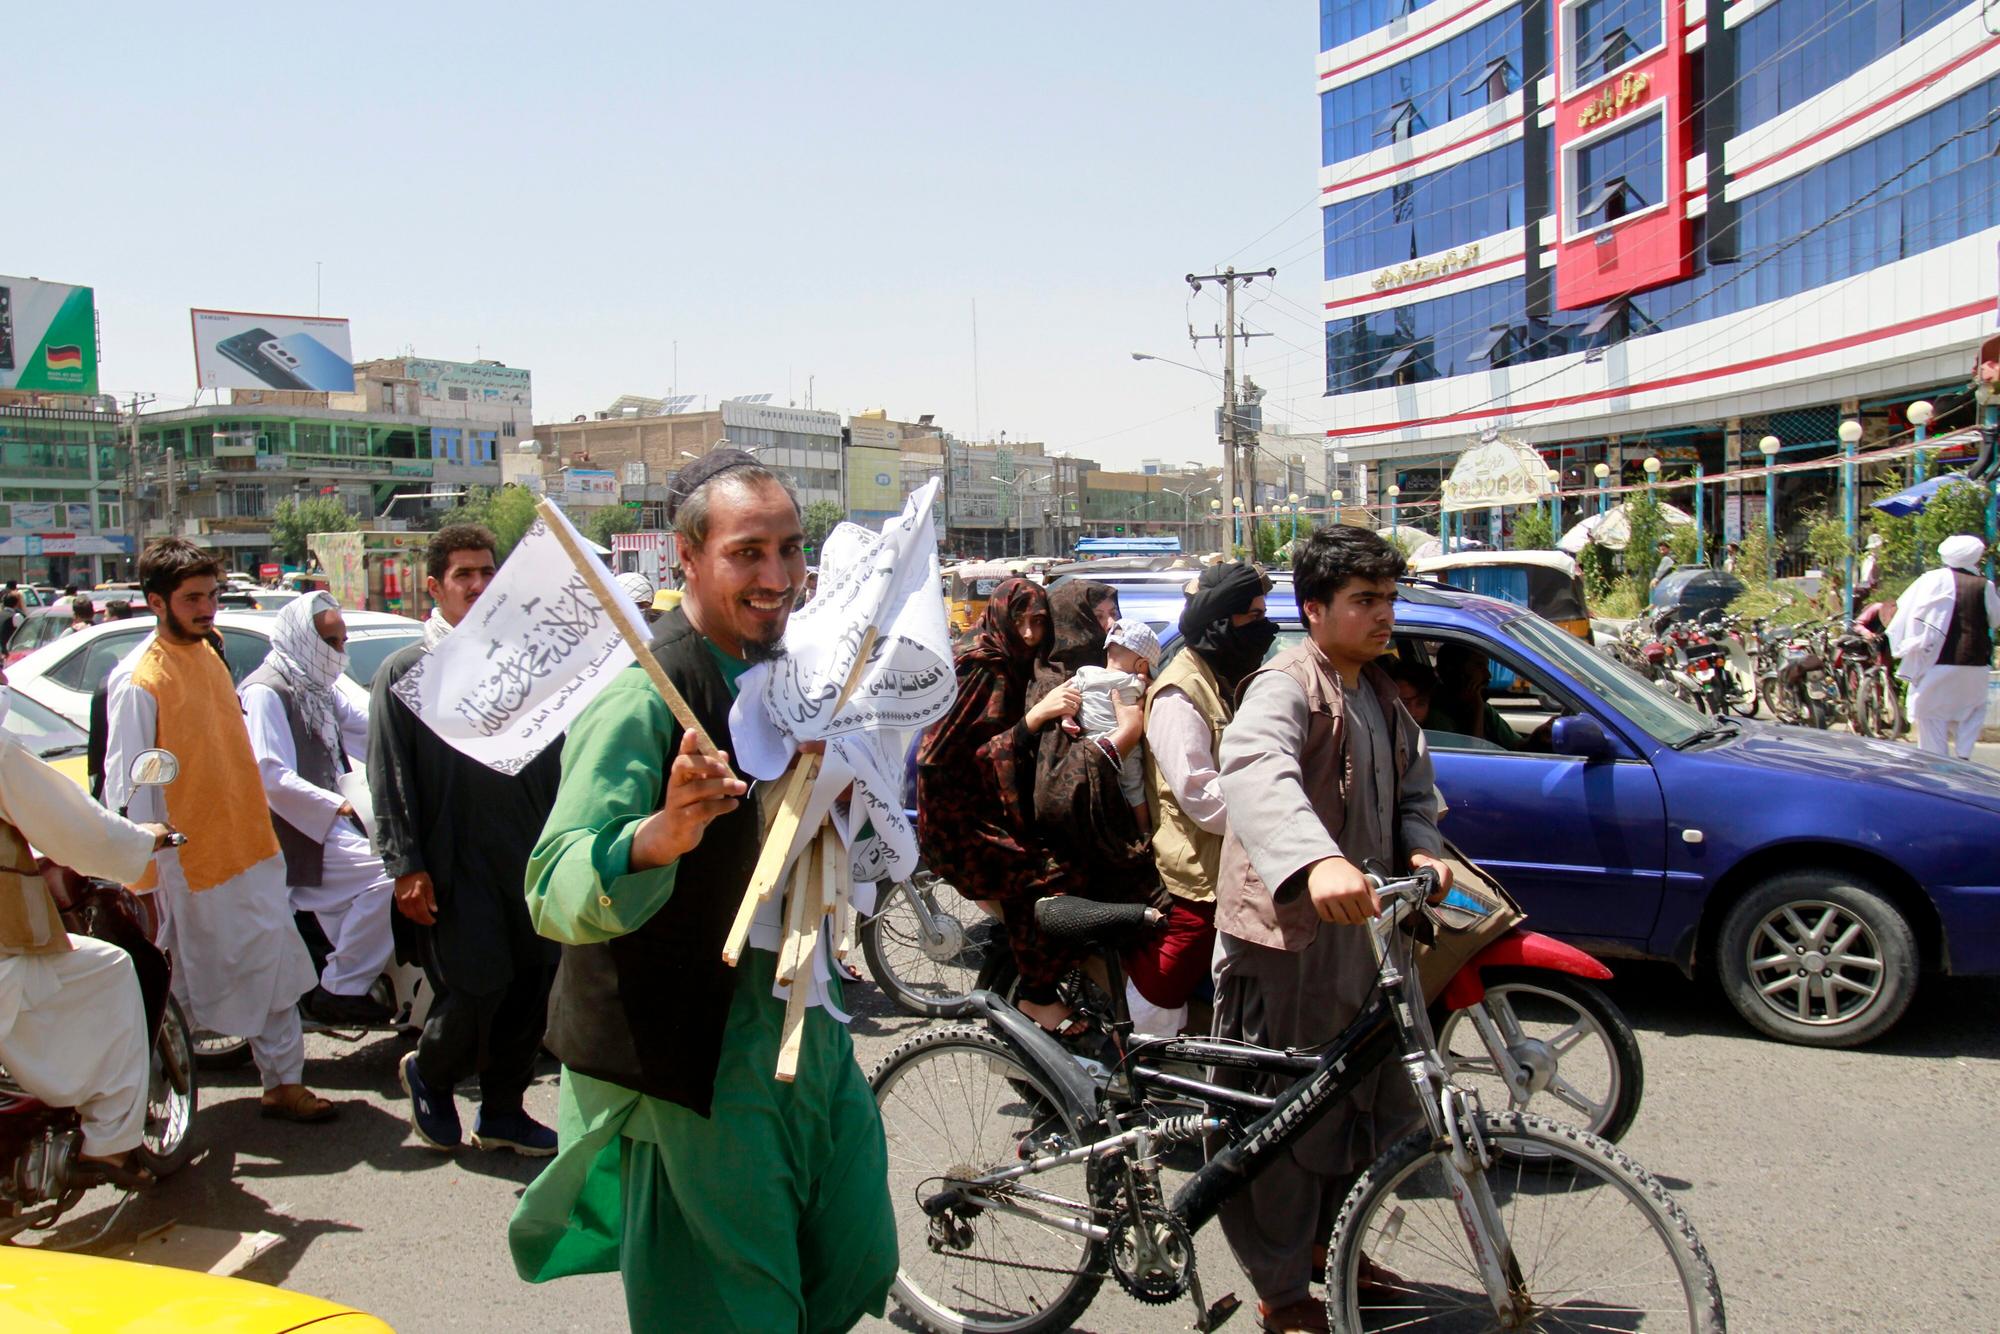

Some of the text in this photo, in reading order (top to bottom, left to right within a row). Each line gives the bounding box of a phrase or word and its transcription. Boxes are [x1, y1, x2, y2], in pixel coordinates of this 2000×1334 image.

[1165, 1045, 1202, 1055] DUAL
[1243, 1053, 1348, 1155] THRIFT
[1272, 1083, 1338, 1145] VELO MODE
